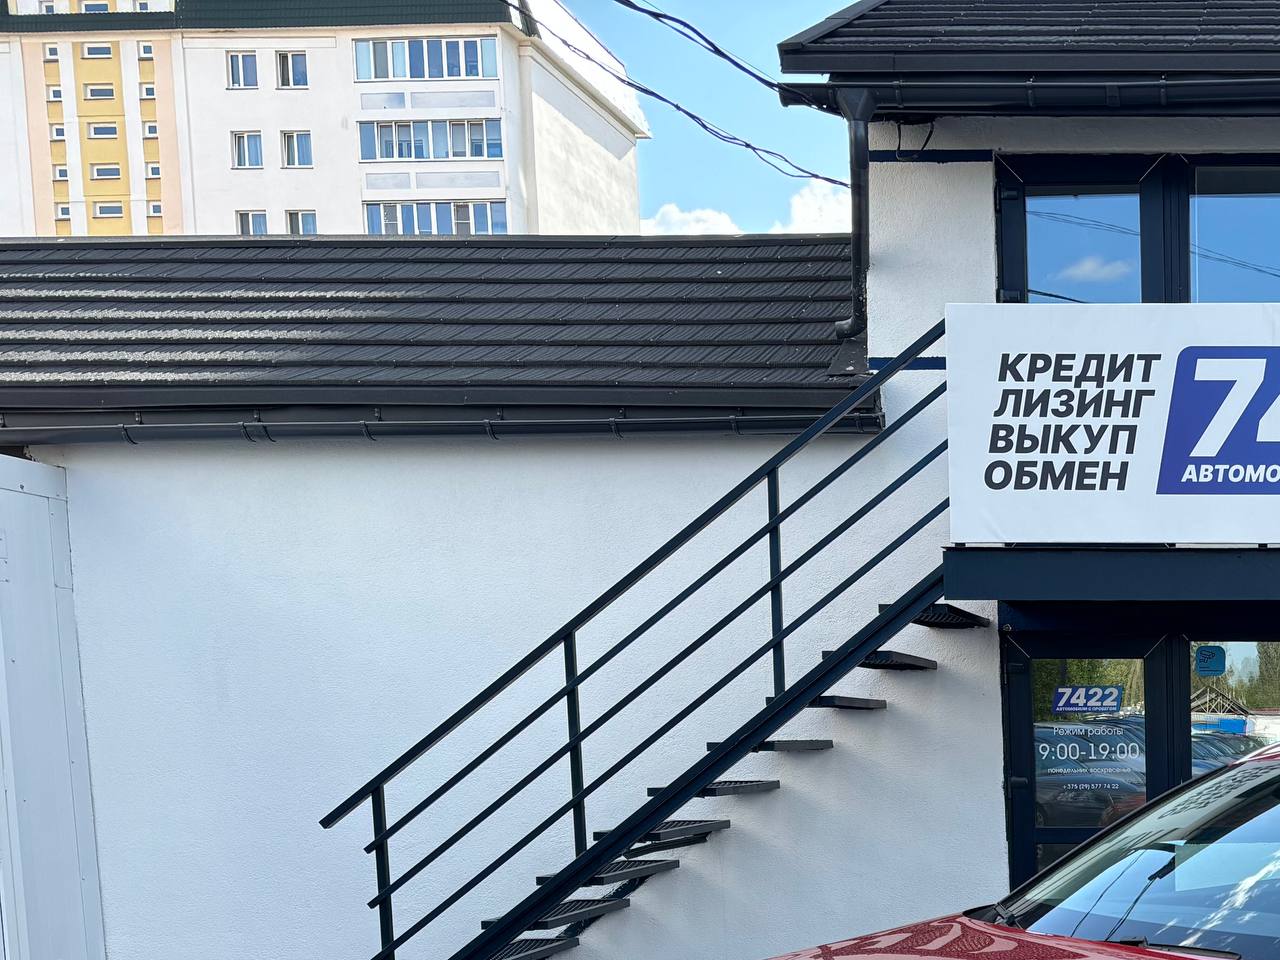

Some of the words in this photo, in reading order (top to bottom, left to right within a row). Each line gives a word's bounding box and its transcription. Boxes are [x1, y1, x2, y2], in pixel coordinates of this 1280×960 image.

[998, 353, 1162, 388] КРЕДИТ
[993, 389, 1156, 418] ЛИЗИНГ
[988, 424, 1138, 454] ВЫКУП
[984, 460, 1129, 491] ОБМЕН
[1057, 687, 1119, 706] 7422
[1053, 727, 1085, 736] Режим
[1087, 727, 1124, 737] работы
[1038, 743, 1140, 760] 9:00-19:00
